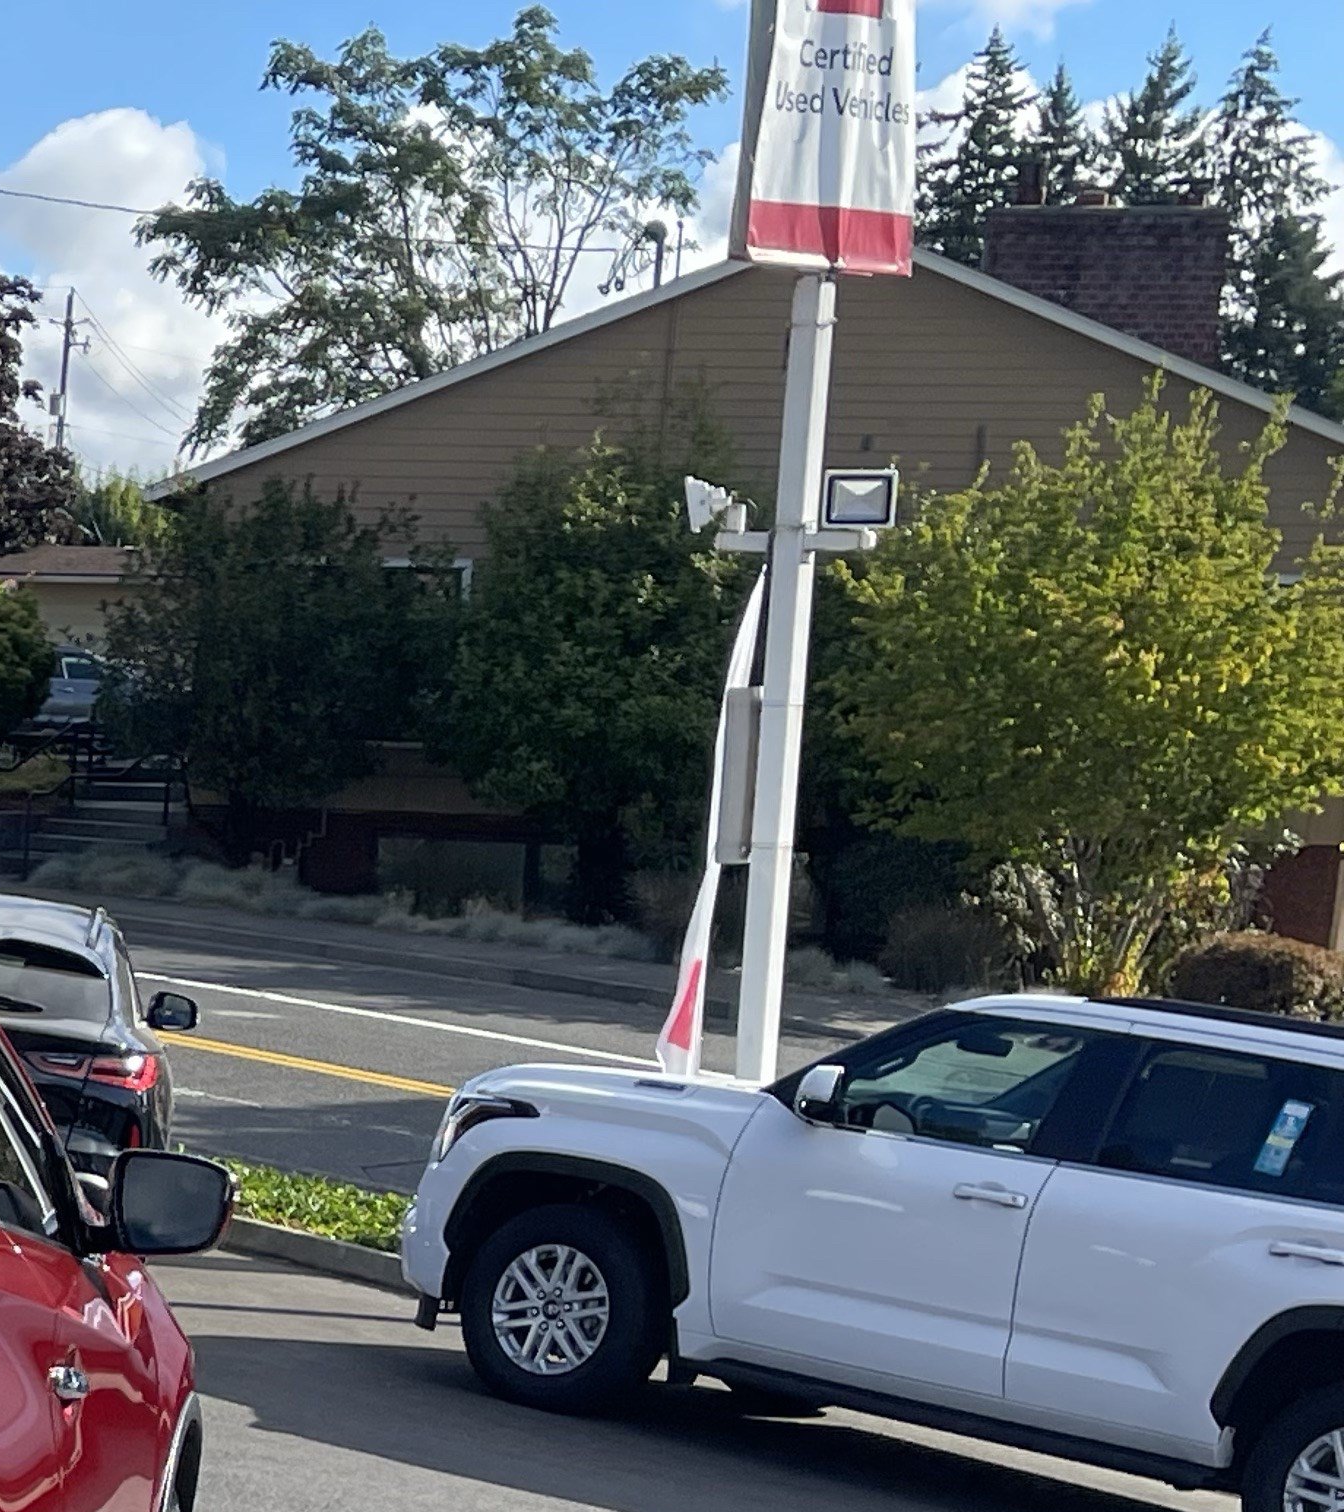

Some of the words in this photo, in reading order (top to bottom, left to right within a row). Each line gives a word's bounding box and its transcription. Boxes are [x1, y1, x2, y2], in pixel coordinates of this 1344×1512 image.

[799, 39, 894, 77] Certified
[775, 80, 826, 115] Used
[832, 87, 910, 126] Vehicles
